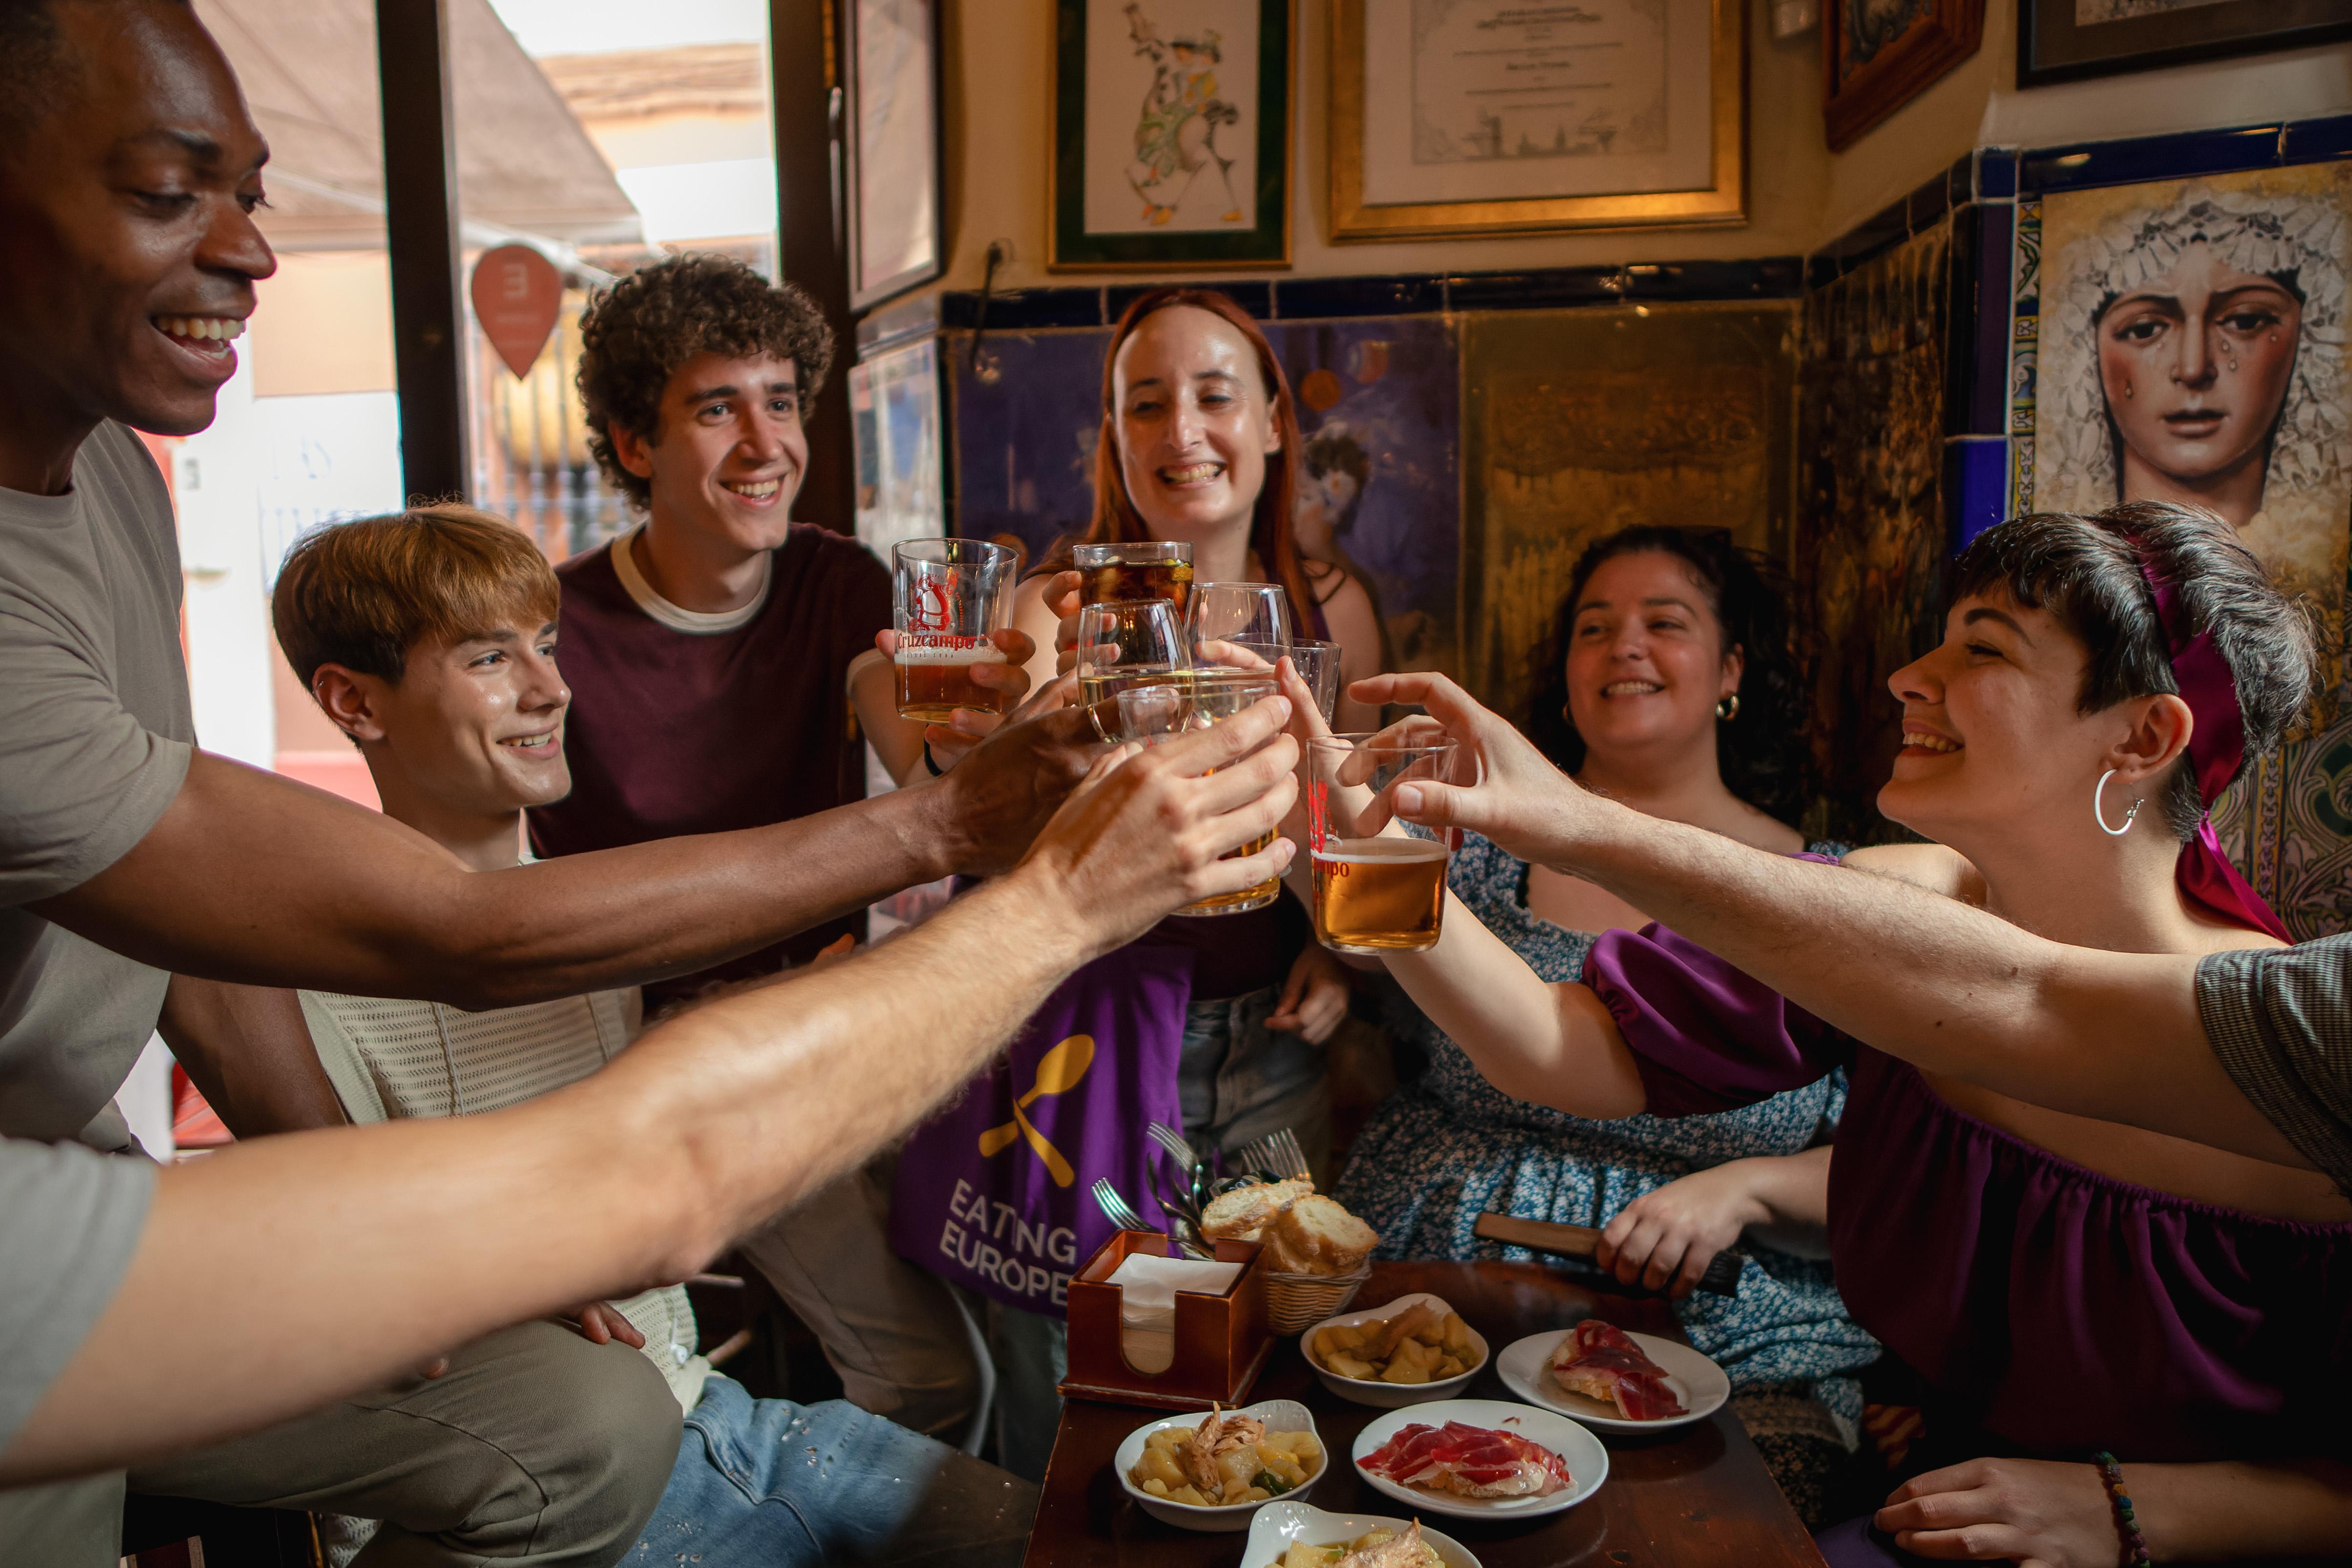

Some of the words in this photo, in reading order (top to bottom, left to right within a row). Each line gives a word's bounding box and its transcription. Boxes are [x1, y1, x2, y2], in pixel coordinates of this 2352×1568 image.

[898, 632, 975, 651] Cruzcampo
[939, 1218, 1074, 1307] EUROPE
[950, 1178, 1076, 1265] EATNG
